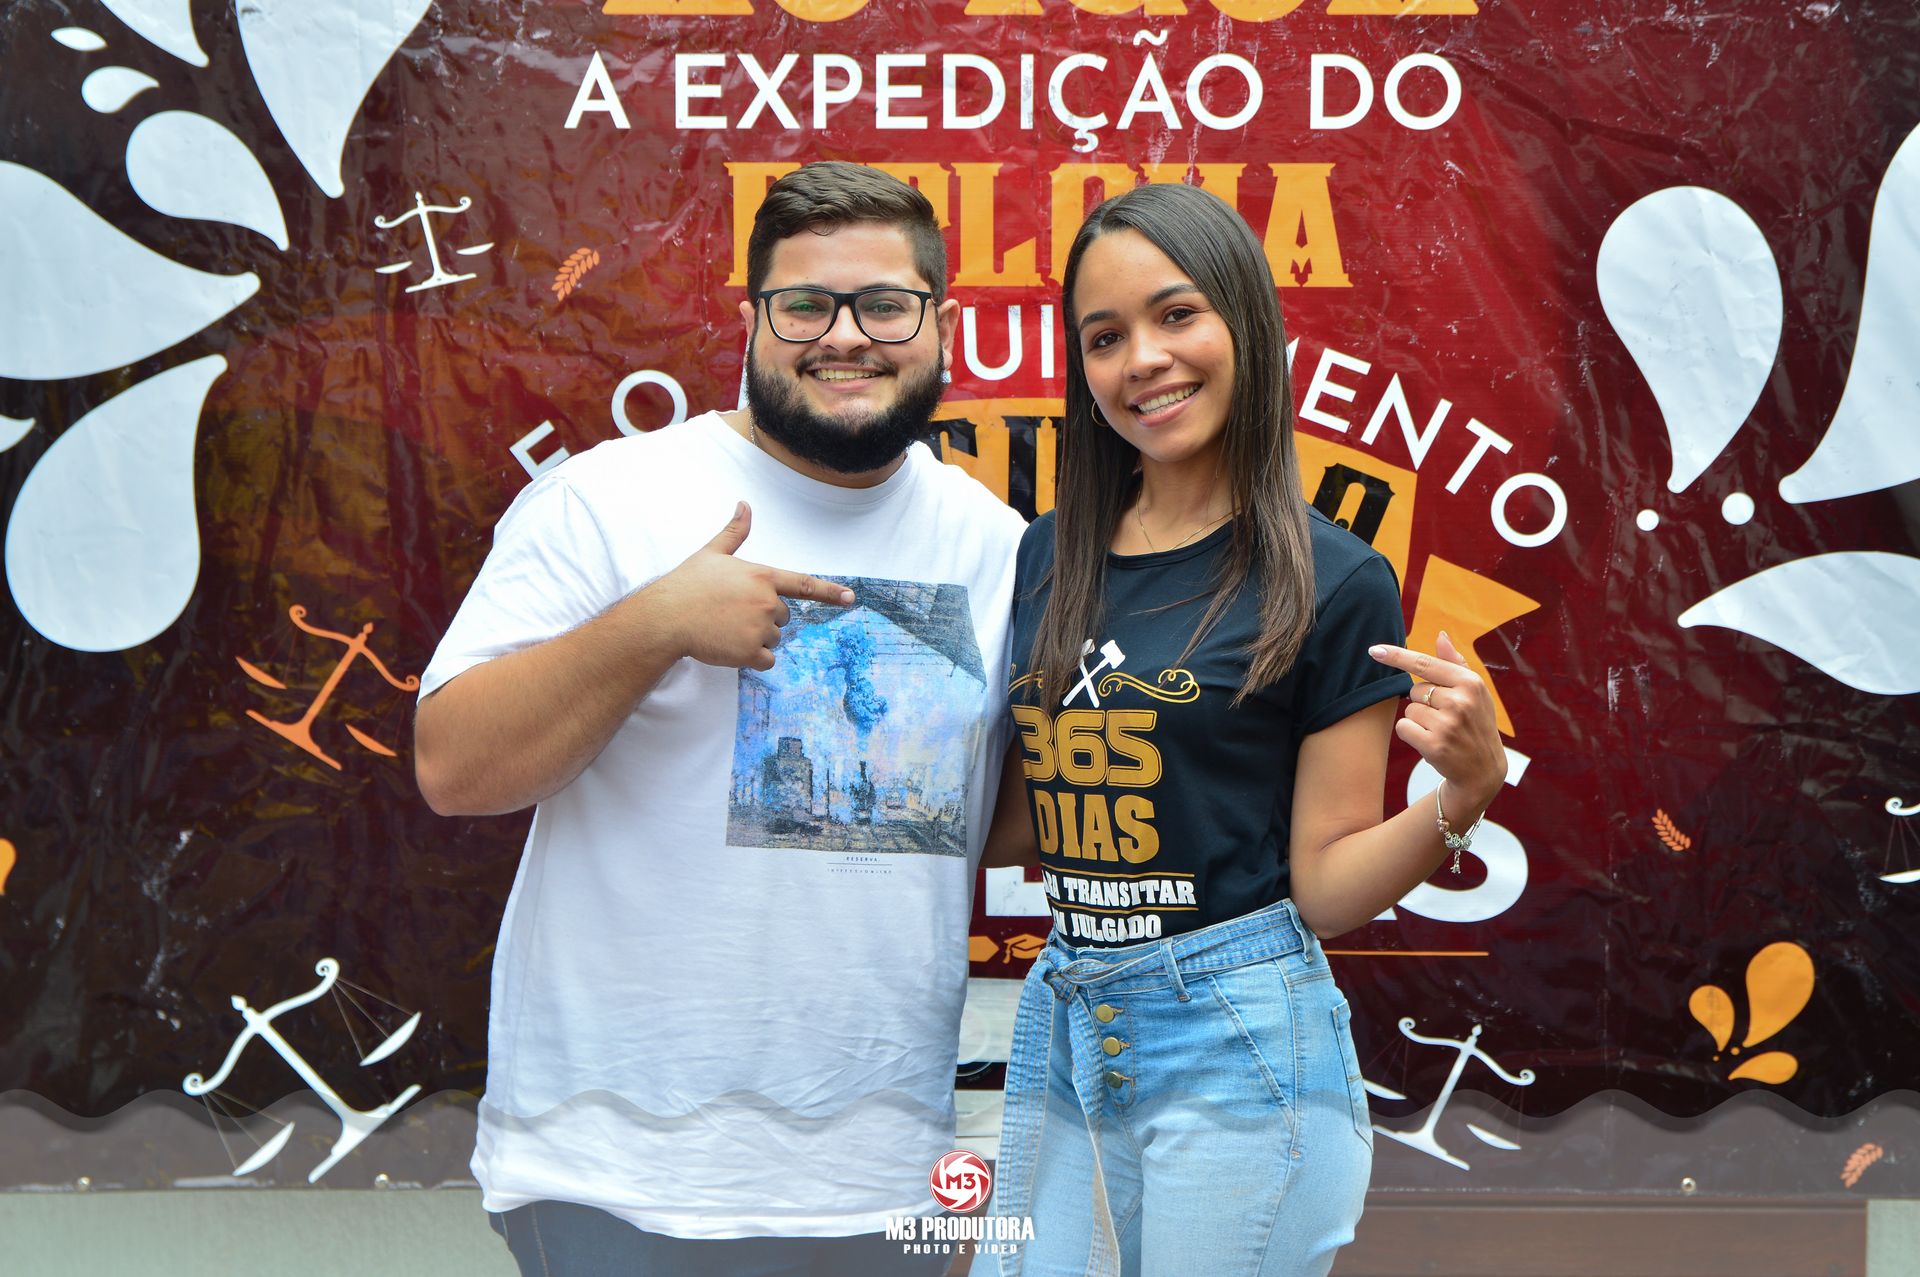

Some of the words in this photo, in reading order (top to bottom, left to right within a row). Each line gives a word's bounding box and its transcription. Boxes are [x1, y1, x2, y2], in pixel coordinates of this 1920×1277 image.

[564, 51, 631, 129] A
[675, 30, 1264, 153] EXPEDIÇÃO
[1310, 53, 1462, 130] DO
[611, 369, 688, 438] O
[1011, 704, 1163, 788] 365
[1034, 789, 1160, 864] DIAS
[1063, 876, 1196, 908] TRANSITAR
[1071, 914, 1162, 943] JULGADO
